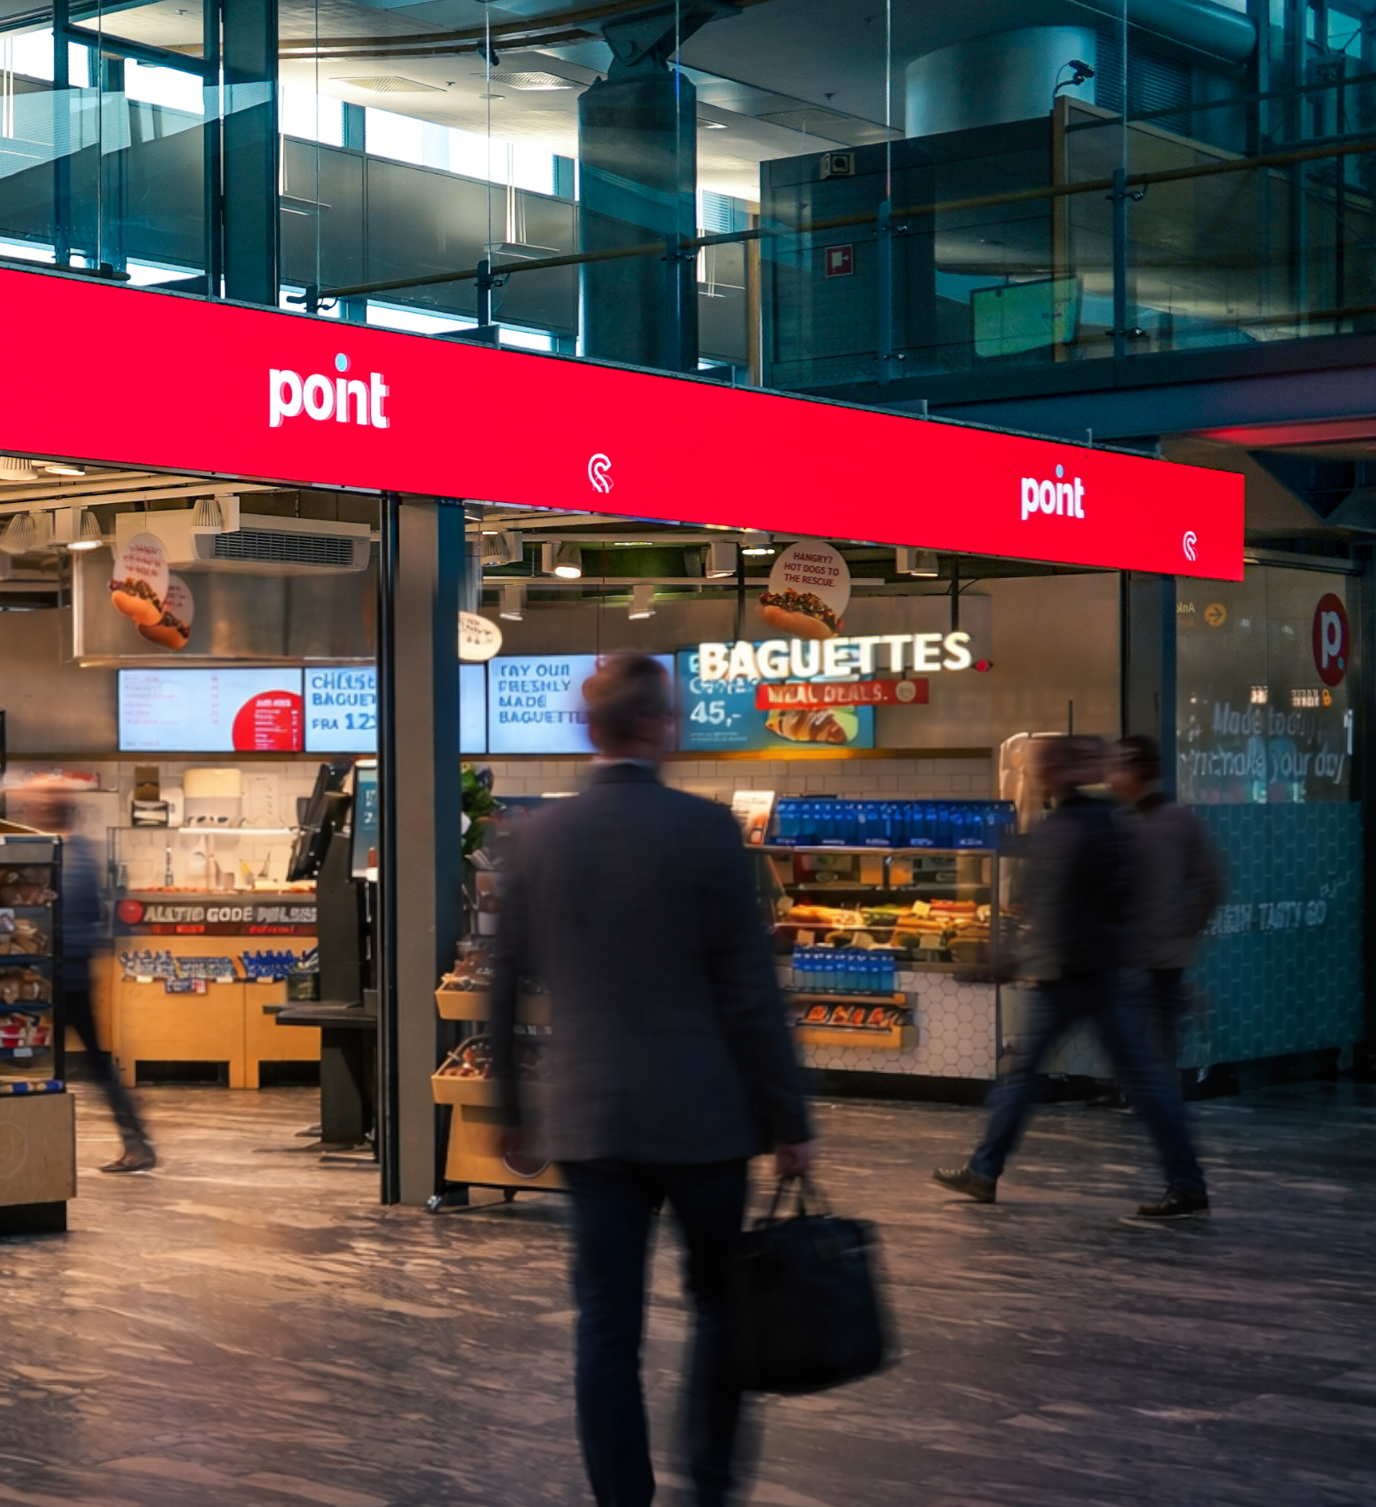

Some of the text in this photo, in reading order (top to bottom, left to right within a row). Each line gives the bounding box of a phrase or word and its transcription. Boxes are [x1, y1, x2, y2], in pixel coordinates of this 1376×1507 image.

[269, 353, 390, 429] point
[1021, 464, 1085, 521] point
[793, 552, 833, 564] HANGRY?
[784, 562, 840, 577] HOT DOGS TO
[784, 573, 801, 583] THE
[206, 907, 253, 923] GODE
